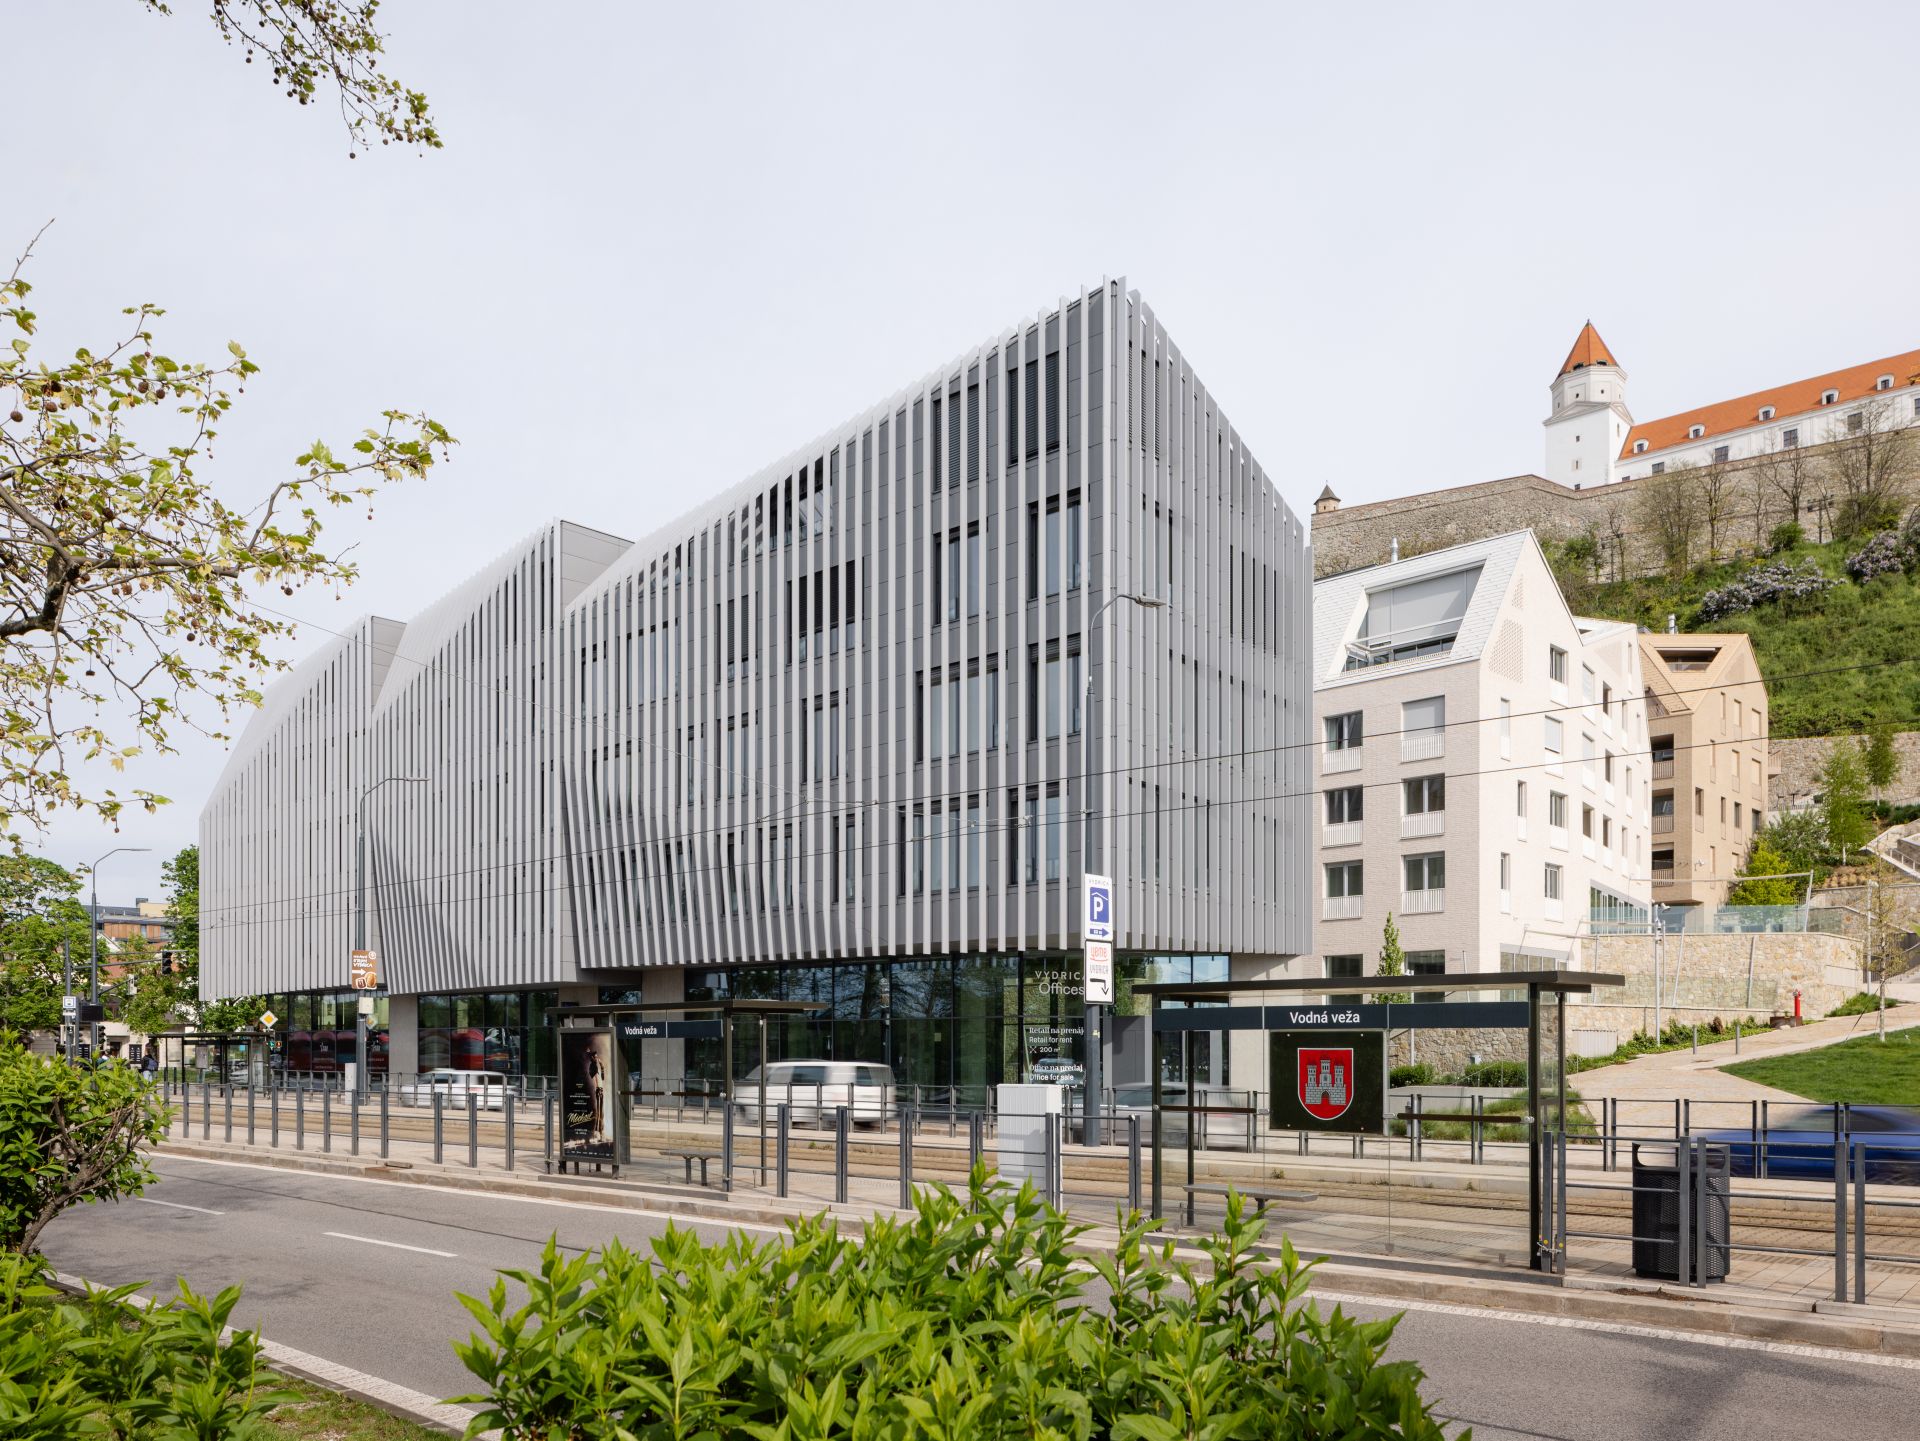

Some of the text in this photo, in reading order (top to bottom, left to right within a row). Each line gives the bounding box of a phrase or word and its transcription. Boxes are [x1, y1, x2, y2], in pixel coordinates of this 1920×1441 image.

[1093, 896, 1104, 920] P
[1038, 981, 1085, 995] Offices
[1289, 1010, 1360, 1024] Vodná veža
[624, 1025, 658, 1035] Vodná veža
[1029, 1036, 1048, 1044] Retail
[1048, 1036, 1058, 1044] for
[1029, 1063, 1049, 1072] Office
[1060, 1063, 1083, 1073] predaj
[1029, 1073, 1074, 1081] Office for sale
